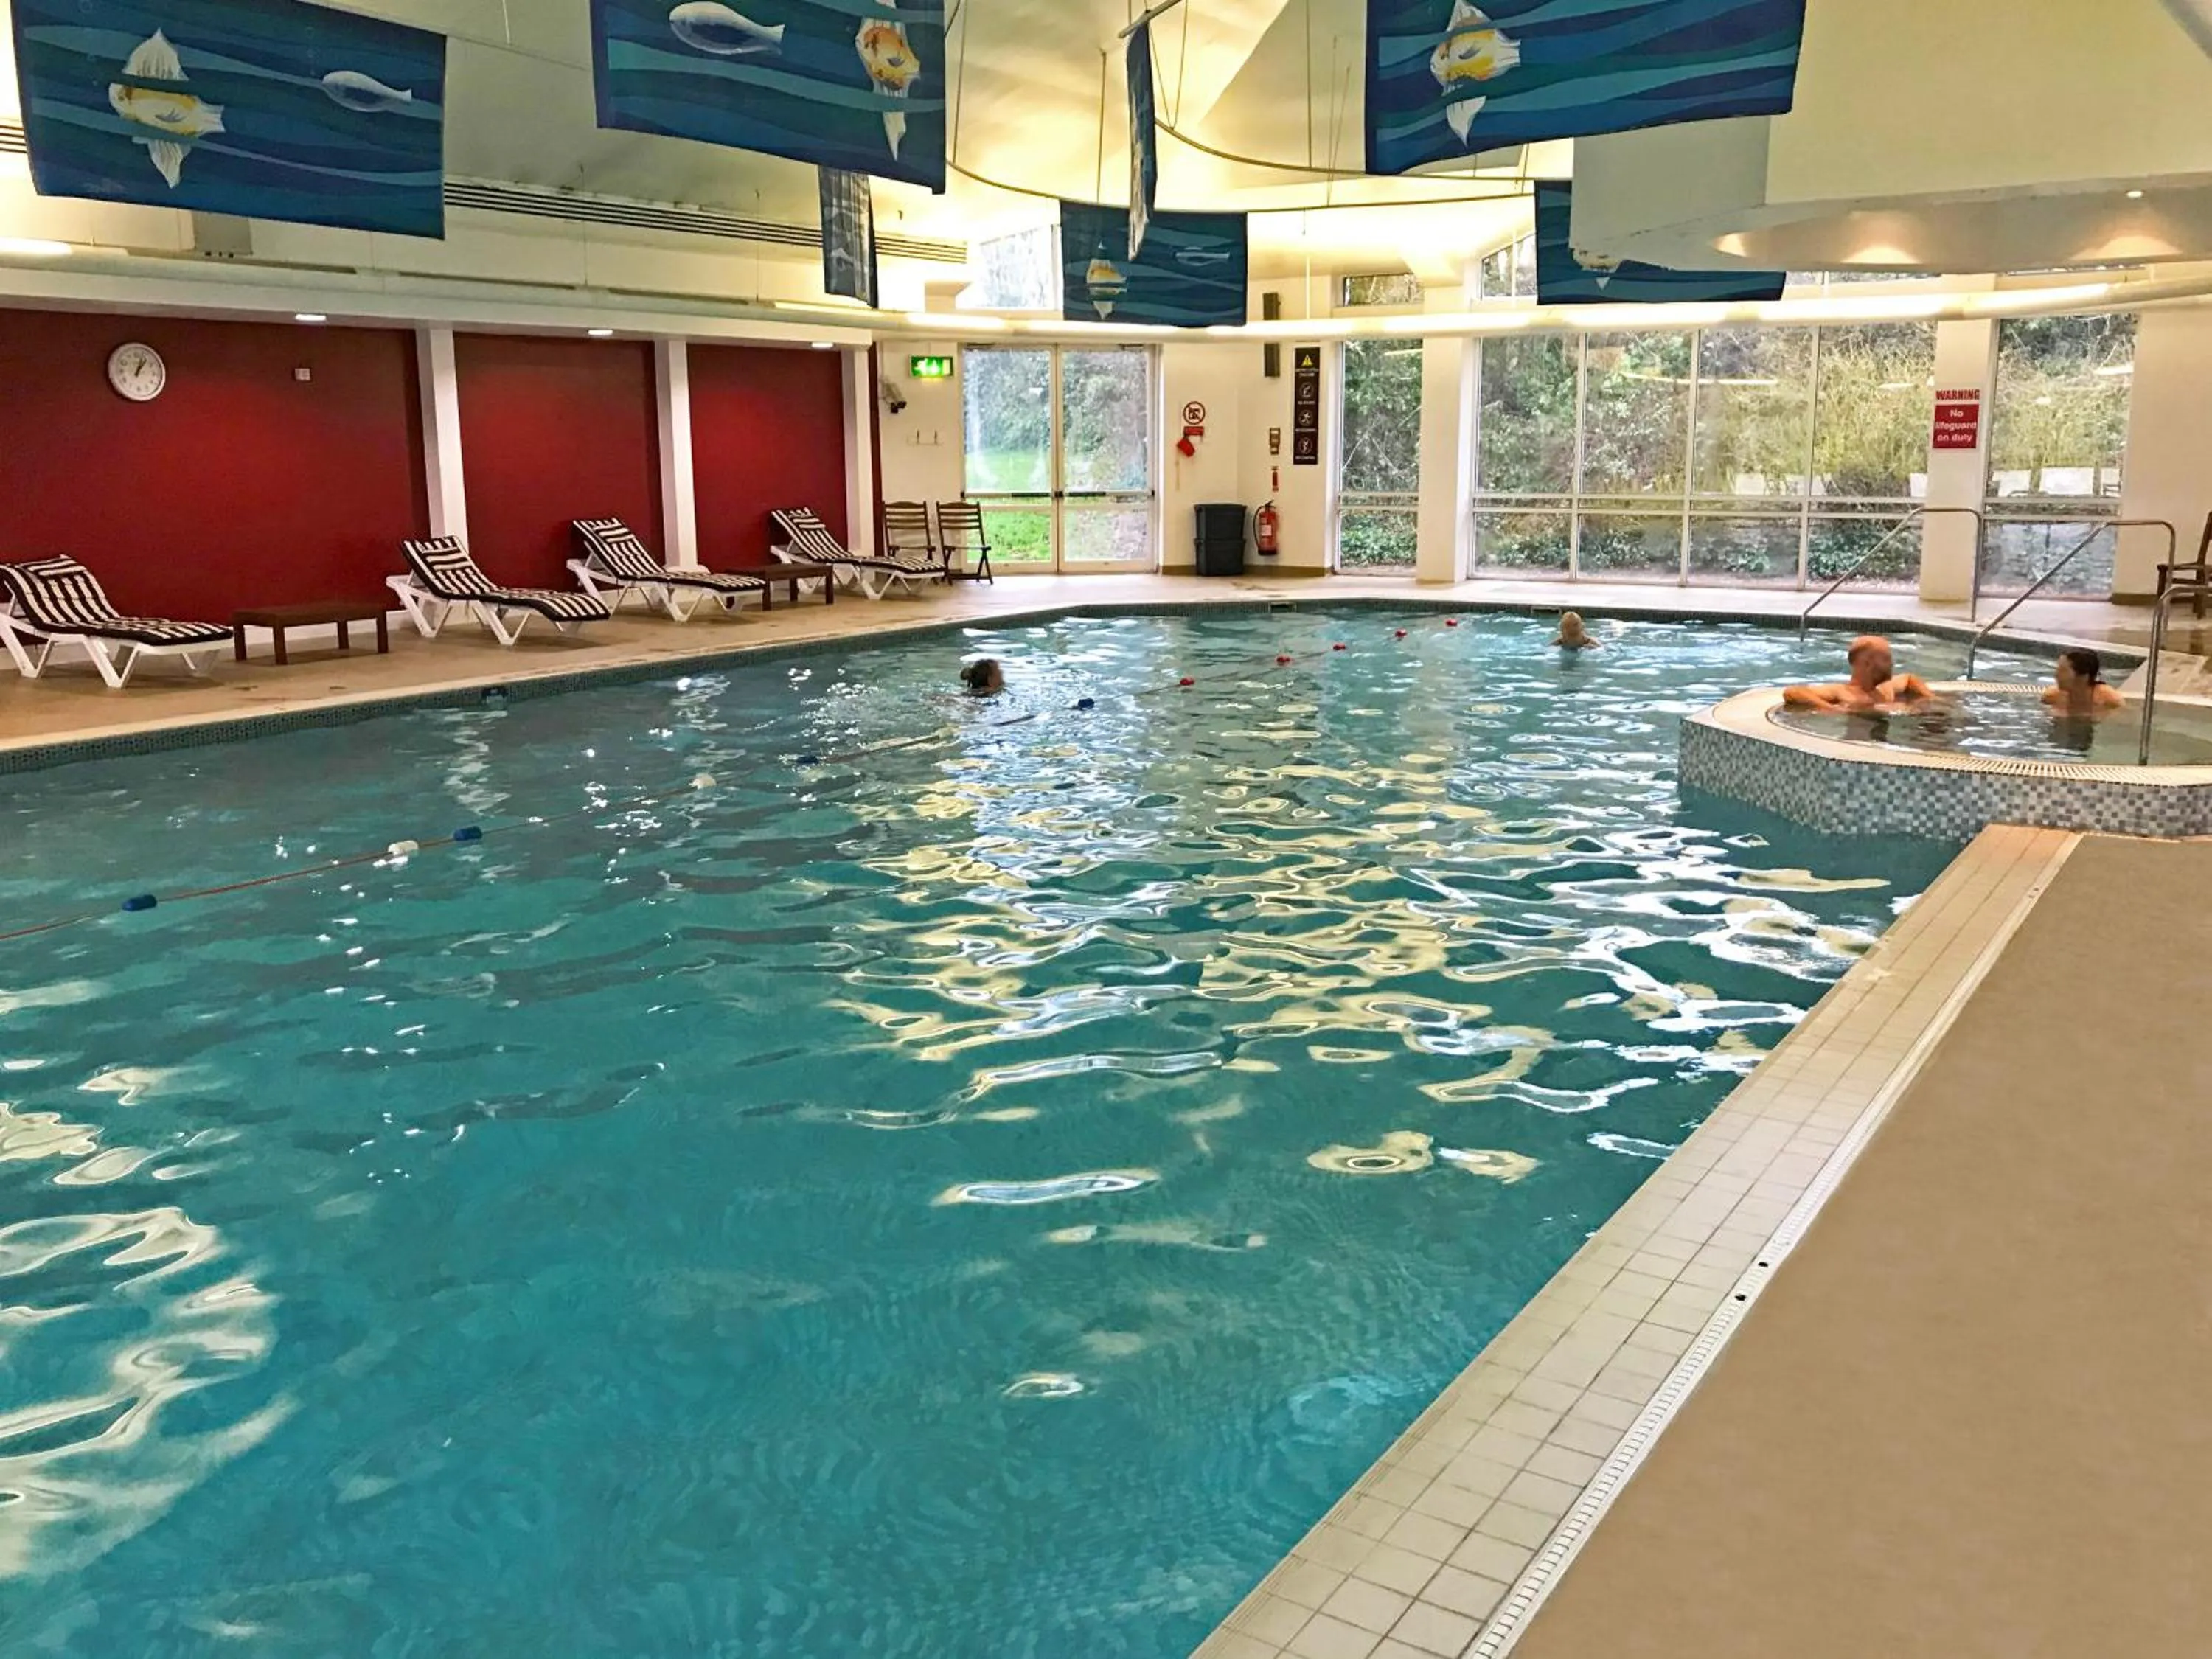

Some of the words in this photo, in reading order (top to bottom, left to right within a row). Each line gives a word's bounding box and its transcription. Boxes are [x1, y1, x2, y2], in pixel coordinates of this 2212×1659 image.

[1936, 389, 1980, 400] WARNING
[1950, 409, 1964, 417] No
[1952, 434, 1972, 442] duty
